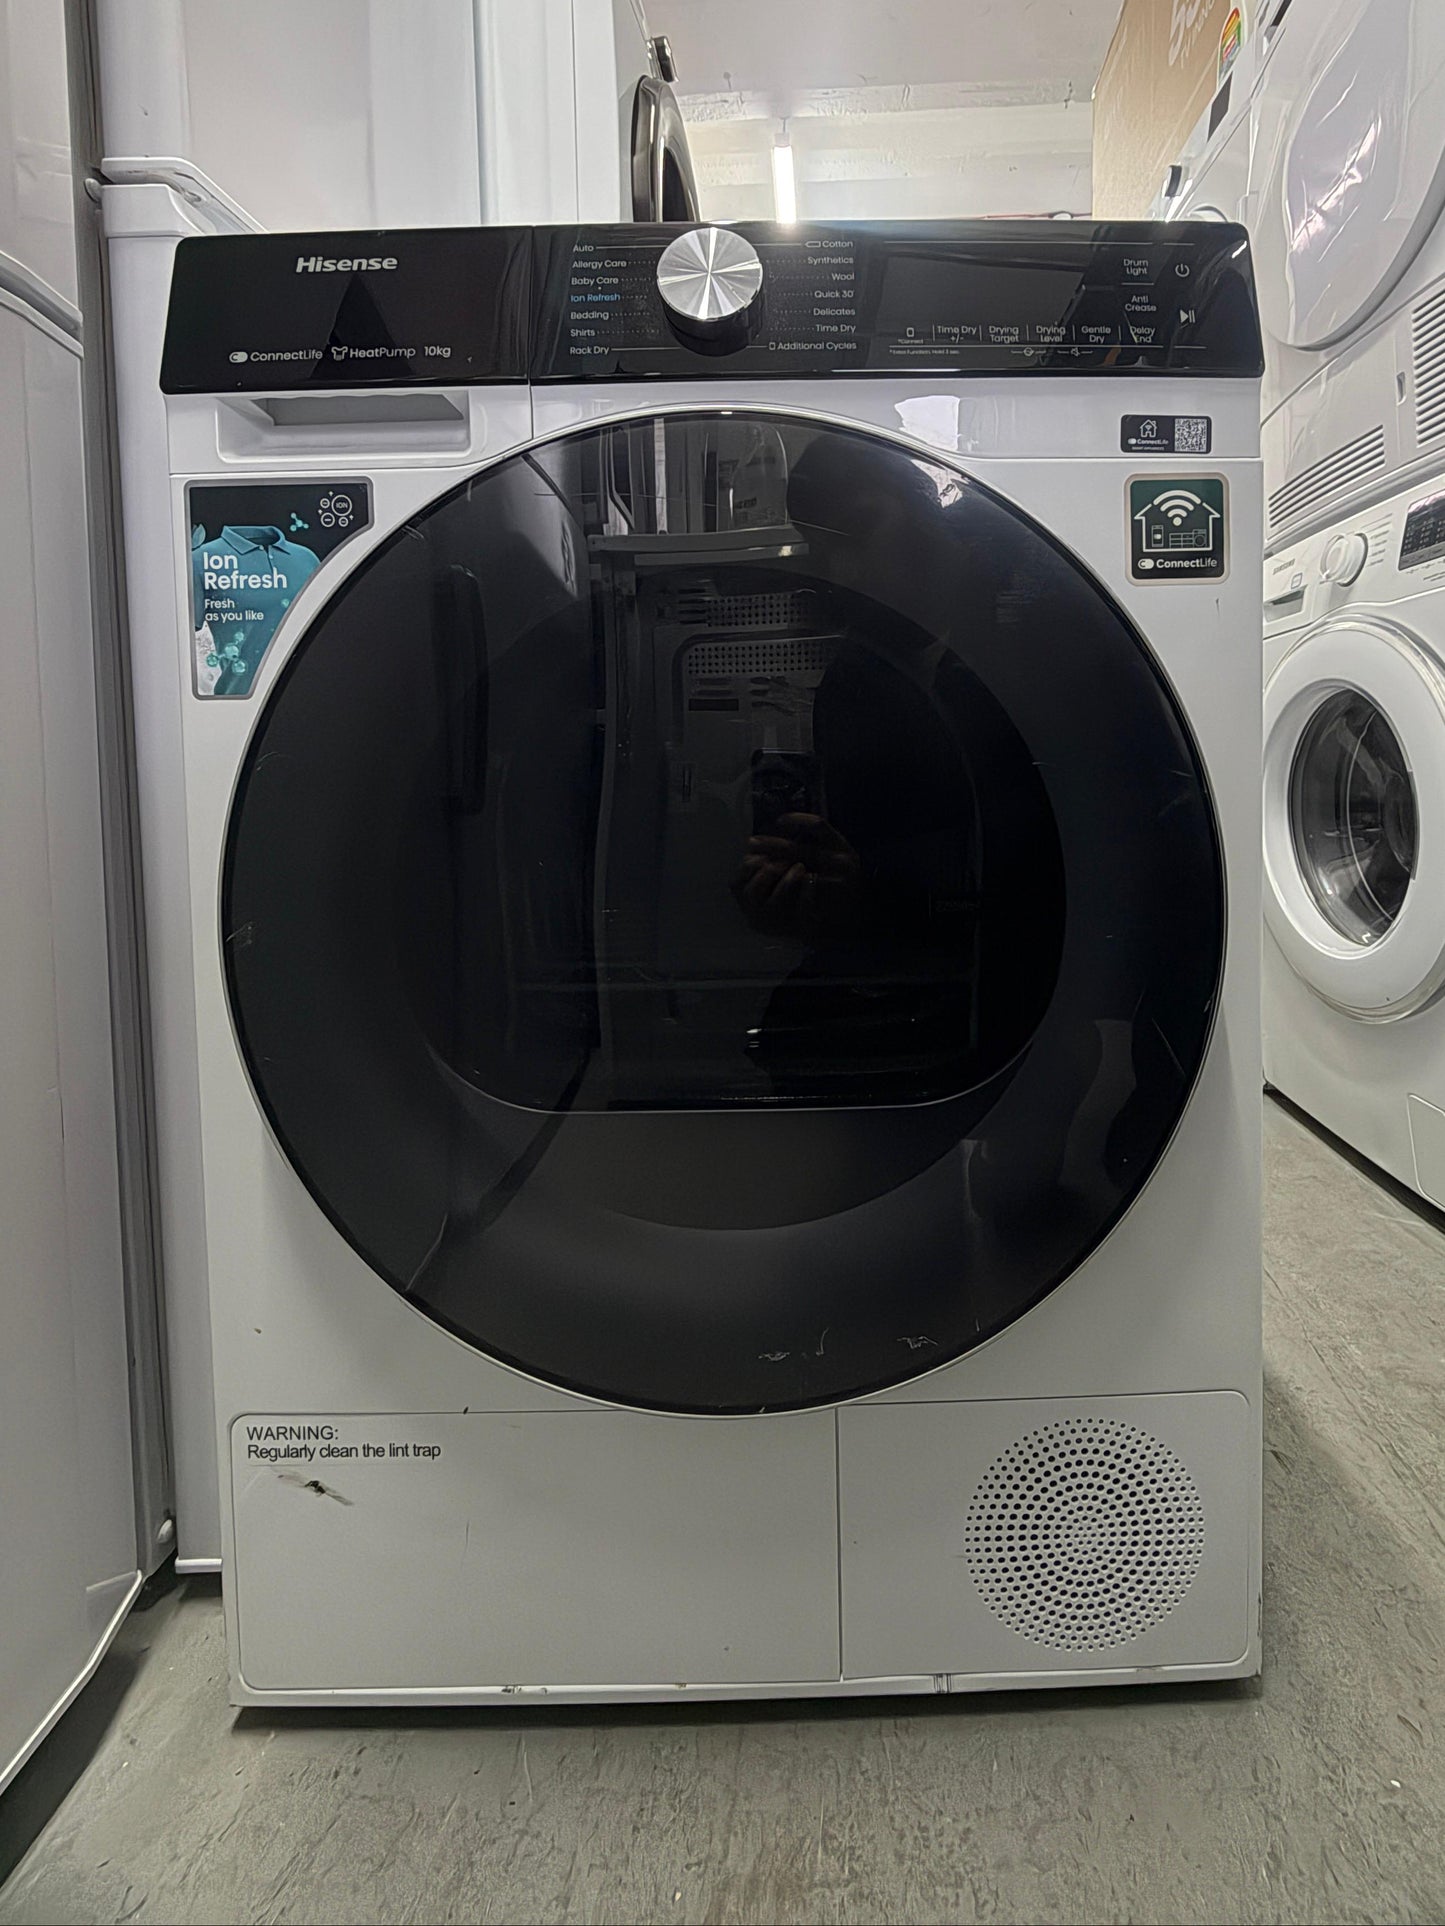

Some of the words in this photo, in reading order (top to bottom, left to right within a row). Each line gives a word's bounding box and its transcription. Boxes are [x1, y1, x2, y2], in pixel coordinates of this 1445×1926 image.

[573, 244, 594, 253] Auto
[296, 256, 398, 273] Hisense
[572, 261, 602, 269] Allergy
[604, 260, 627, 268] Care
[807, 256, 854, 266] Synthetics
[1123, 259, 1149, 267] Drum
[1126, 266, 1148, 276] Light
[571, 277, 595, 286] Baby
[596, 277, 619, 285] Care
[831, 273, 855, 281] Wool
[571, 295, 586, 303] Ion
[587, 293, 621, 302] Refresh
[814, 290, 840, 299] Quick
[1131, 295, 1149, 303] Anti
[813, 308, 856, 316] Delicates
[1124, 303, 1157, 312] Crease
[570, 311, 610, 320] Bedding
[570, 328, 596, 337] Shirts
[815, 324, 839, 332] Time
[840, 324, 857, 334] Dry
[937, 325, 960, 334] Time
[961, 325, 977, 335] Dry
[988, 325, 1019, 335] Drying
[1035, 325, 1066, 335] Drying
[1081, 325, 1111, 334] Gentle
[1130, 325, 1155, 337] Delay
[990, 334, 1019, 344] Target
[1040, 334, 1063, 343] Level
[1089, 334, 1105, 344] Dry
[570, 346, 592, 355] Rack
[593, 346, 610, 355] Dry
[777, 341, 825, 350] Additional
[826, 341, 857, 351] Cycles
[250, 350, 323, 362] ConnectLife
[350, 347, 416, 359] HeatPump
[424, 346, 451, 358] 10kg
[203, 552, 238, 570] Ion
[1156, 557, 1218, 569] ConnectLife
[204, 567, 288, 590] Refresh
[204, 598, 235, 609] Fresh
[205, 613, 219, 621] as
[221, 612, 243, 623] you
[245, 610, 264, 621] like
[246, 1426, 339, 1441] WARNING:
[247, 1445, 315, 1462] Regularly
[319, 1444, 359, 1459] clean
[362, 1443, 385, 1458] the
[389, 1443, 410, 1457] lint
[413, 1443, 442, 1460] trap
